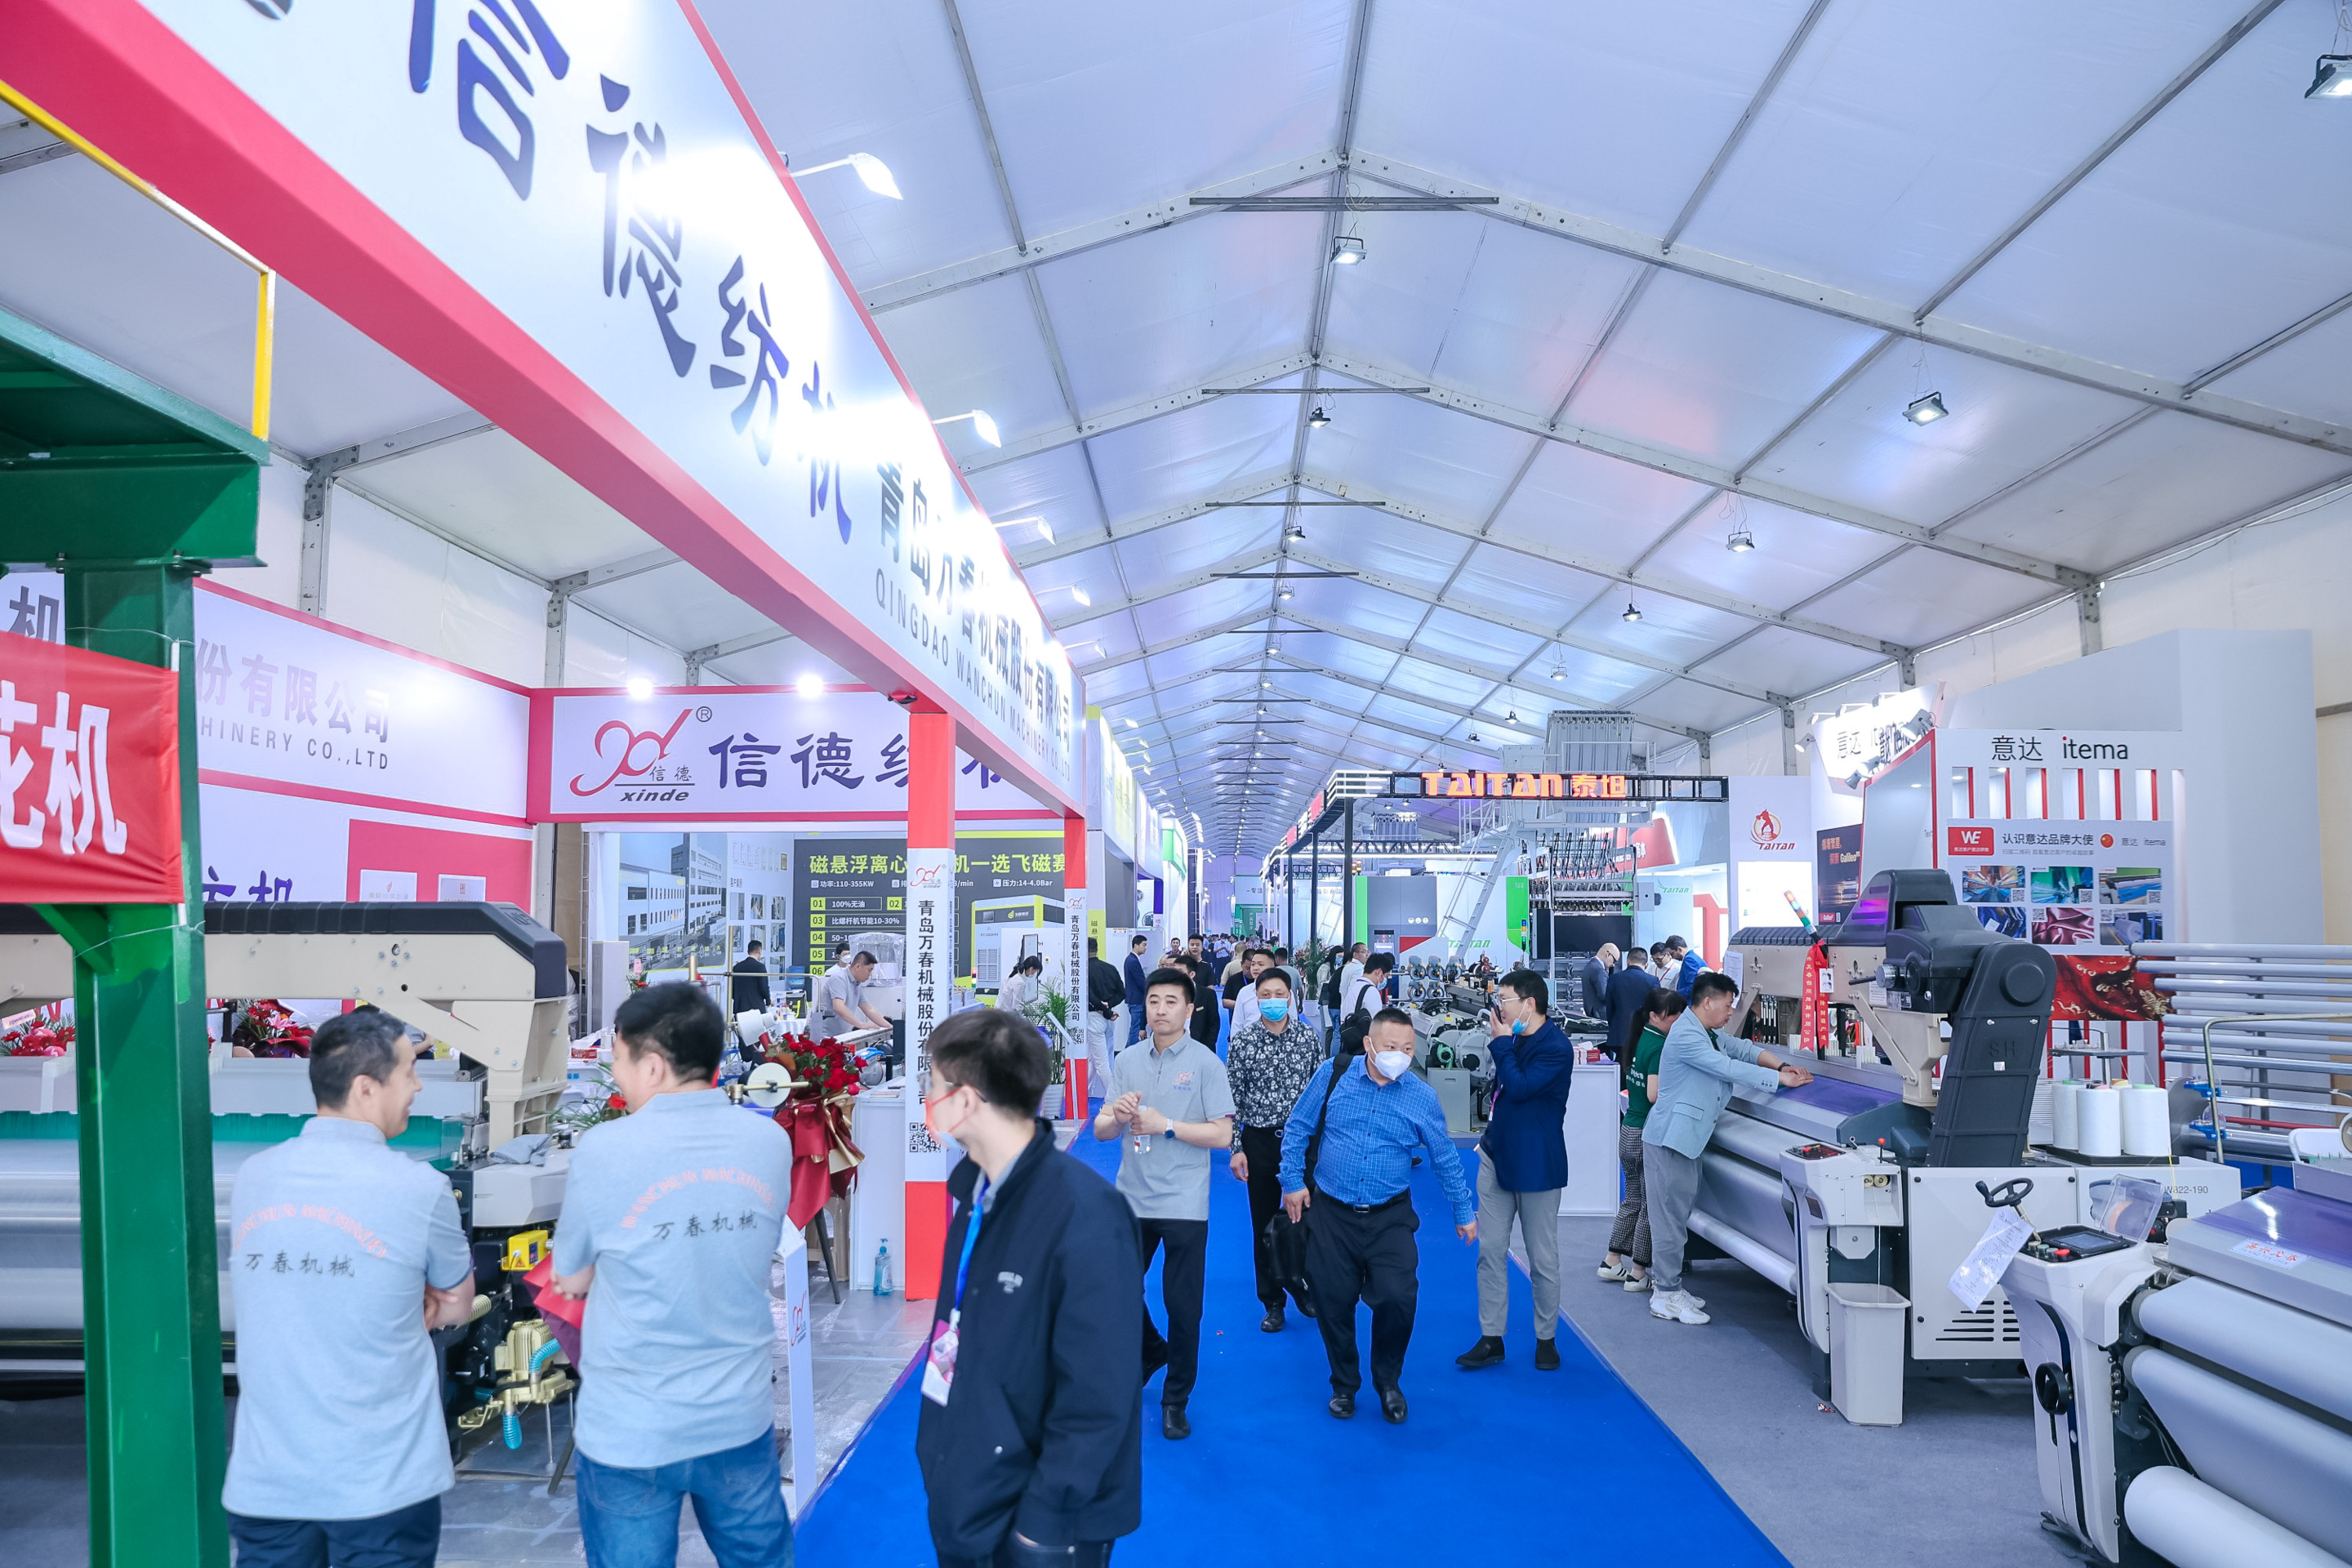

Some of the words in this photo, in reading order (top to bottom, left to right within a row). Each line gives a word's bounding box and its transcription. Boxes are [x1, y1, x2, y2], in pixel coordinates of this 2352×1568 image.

[875, 568, 950, 667] QINGDAO
[956, 648, 1006, 724] WANCHUN
[1009, 705, 1049, 764] MACHINERY
[1991, 735, 2043, 761] 意达
[2062, 736, 2128, 760] itema
[650, 764, 692, 782] 信德
[1571, 774, 1627, 798] 泰坦
[620, 789, 690, 802] xinde
[1961, 831, 1982, 844] WE
[2002, 833, 2094, 846] 认识意达品牌大使
[813, 900, 823, 908] 01
[831, 900, 866, 908] 100%无油
[889, 899, 900, 908] 02
[813, 916, 823, 924] 03
[813, 933, 823, 942] 04
[813, 950, 823, 958] 05
[813, 967, 823, 975] 06
[1071, 915, 1080, 1022] 青岛万春机械股份有限公司
[653, 1209, 757, 1241] 万春机械
[246, 1250, 354, 1277] 万春机械
